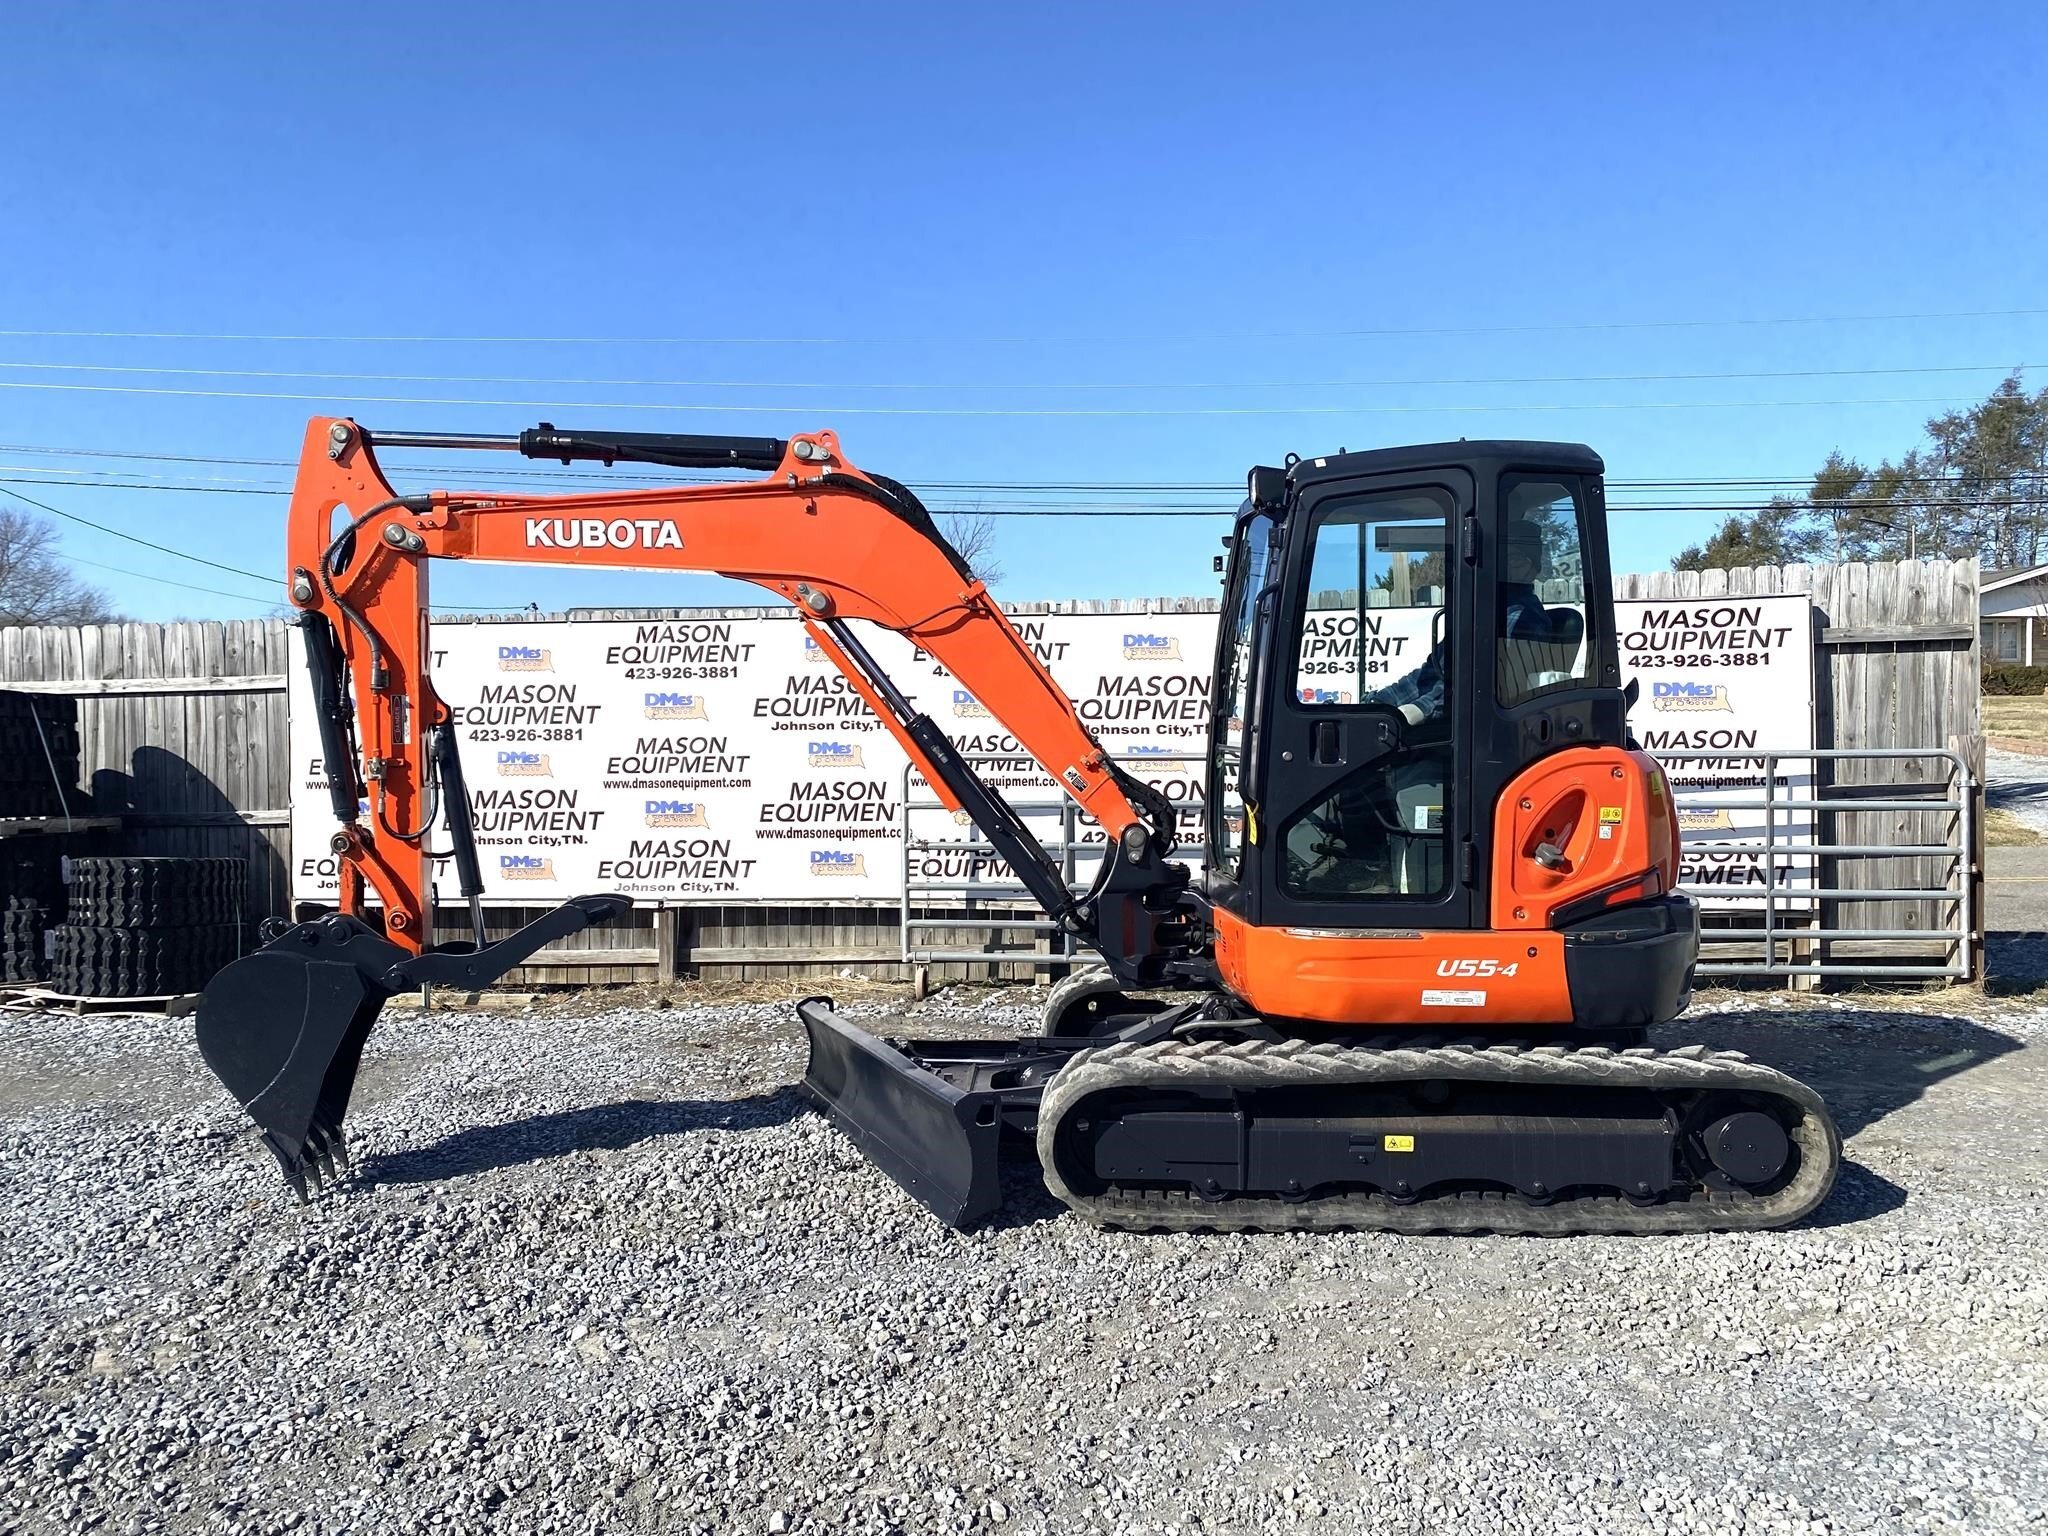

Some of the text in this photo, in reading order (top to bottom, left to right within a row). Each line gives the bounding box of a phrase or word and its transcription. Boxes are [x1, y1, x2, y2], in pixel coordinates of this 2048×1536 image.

[525, 518, 685, 549] KUBOTA
[1303, 616, 1383, 637] ASON
[1641, 606, 1762, 630] MASON
[636, 624, 732, 644] MASON
[606, 644, 756, 665] EQUIPMENT
[1628, 652, 1771, 668] 423-926-3881
[625, 666, 738, 680] 423-926-3881
[480, 684, 577, 704] MASON
[1097, 675, 1212, 697] MASON
[453, 705, 602, 726] EQUIPMENT
[469, 728, 584, 742] 423-926-3881
[771, 721, 835, 731] Johnson
[636, 737, 728, 755] MASON
[946, 734, 1025, 753] MASO
[1643, 729, 1758, 750] MASON
[607, 756, 751, 775] EQUIPMENT
[603, 777, 752, 791] www.dmasonequipment.com
[790, 781, 887, 801] MASON
[474, 789, 578, 810] MASON
[760, 802, 901, 823] EQUIPMEN
[528, 834, 589, 847] City,TN.
[629, 840, 731, 859] MASON
[597, 860, 757, 879] EQUIPMENT
[614, 882, 740, 893] Johnson City,TN.
[1436, 959, 1519, 977] U55-4
